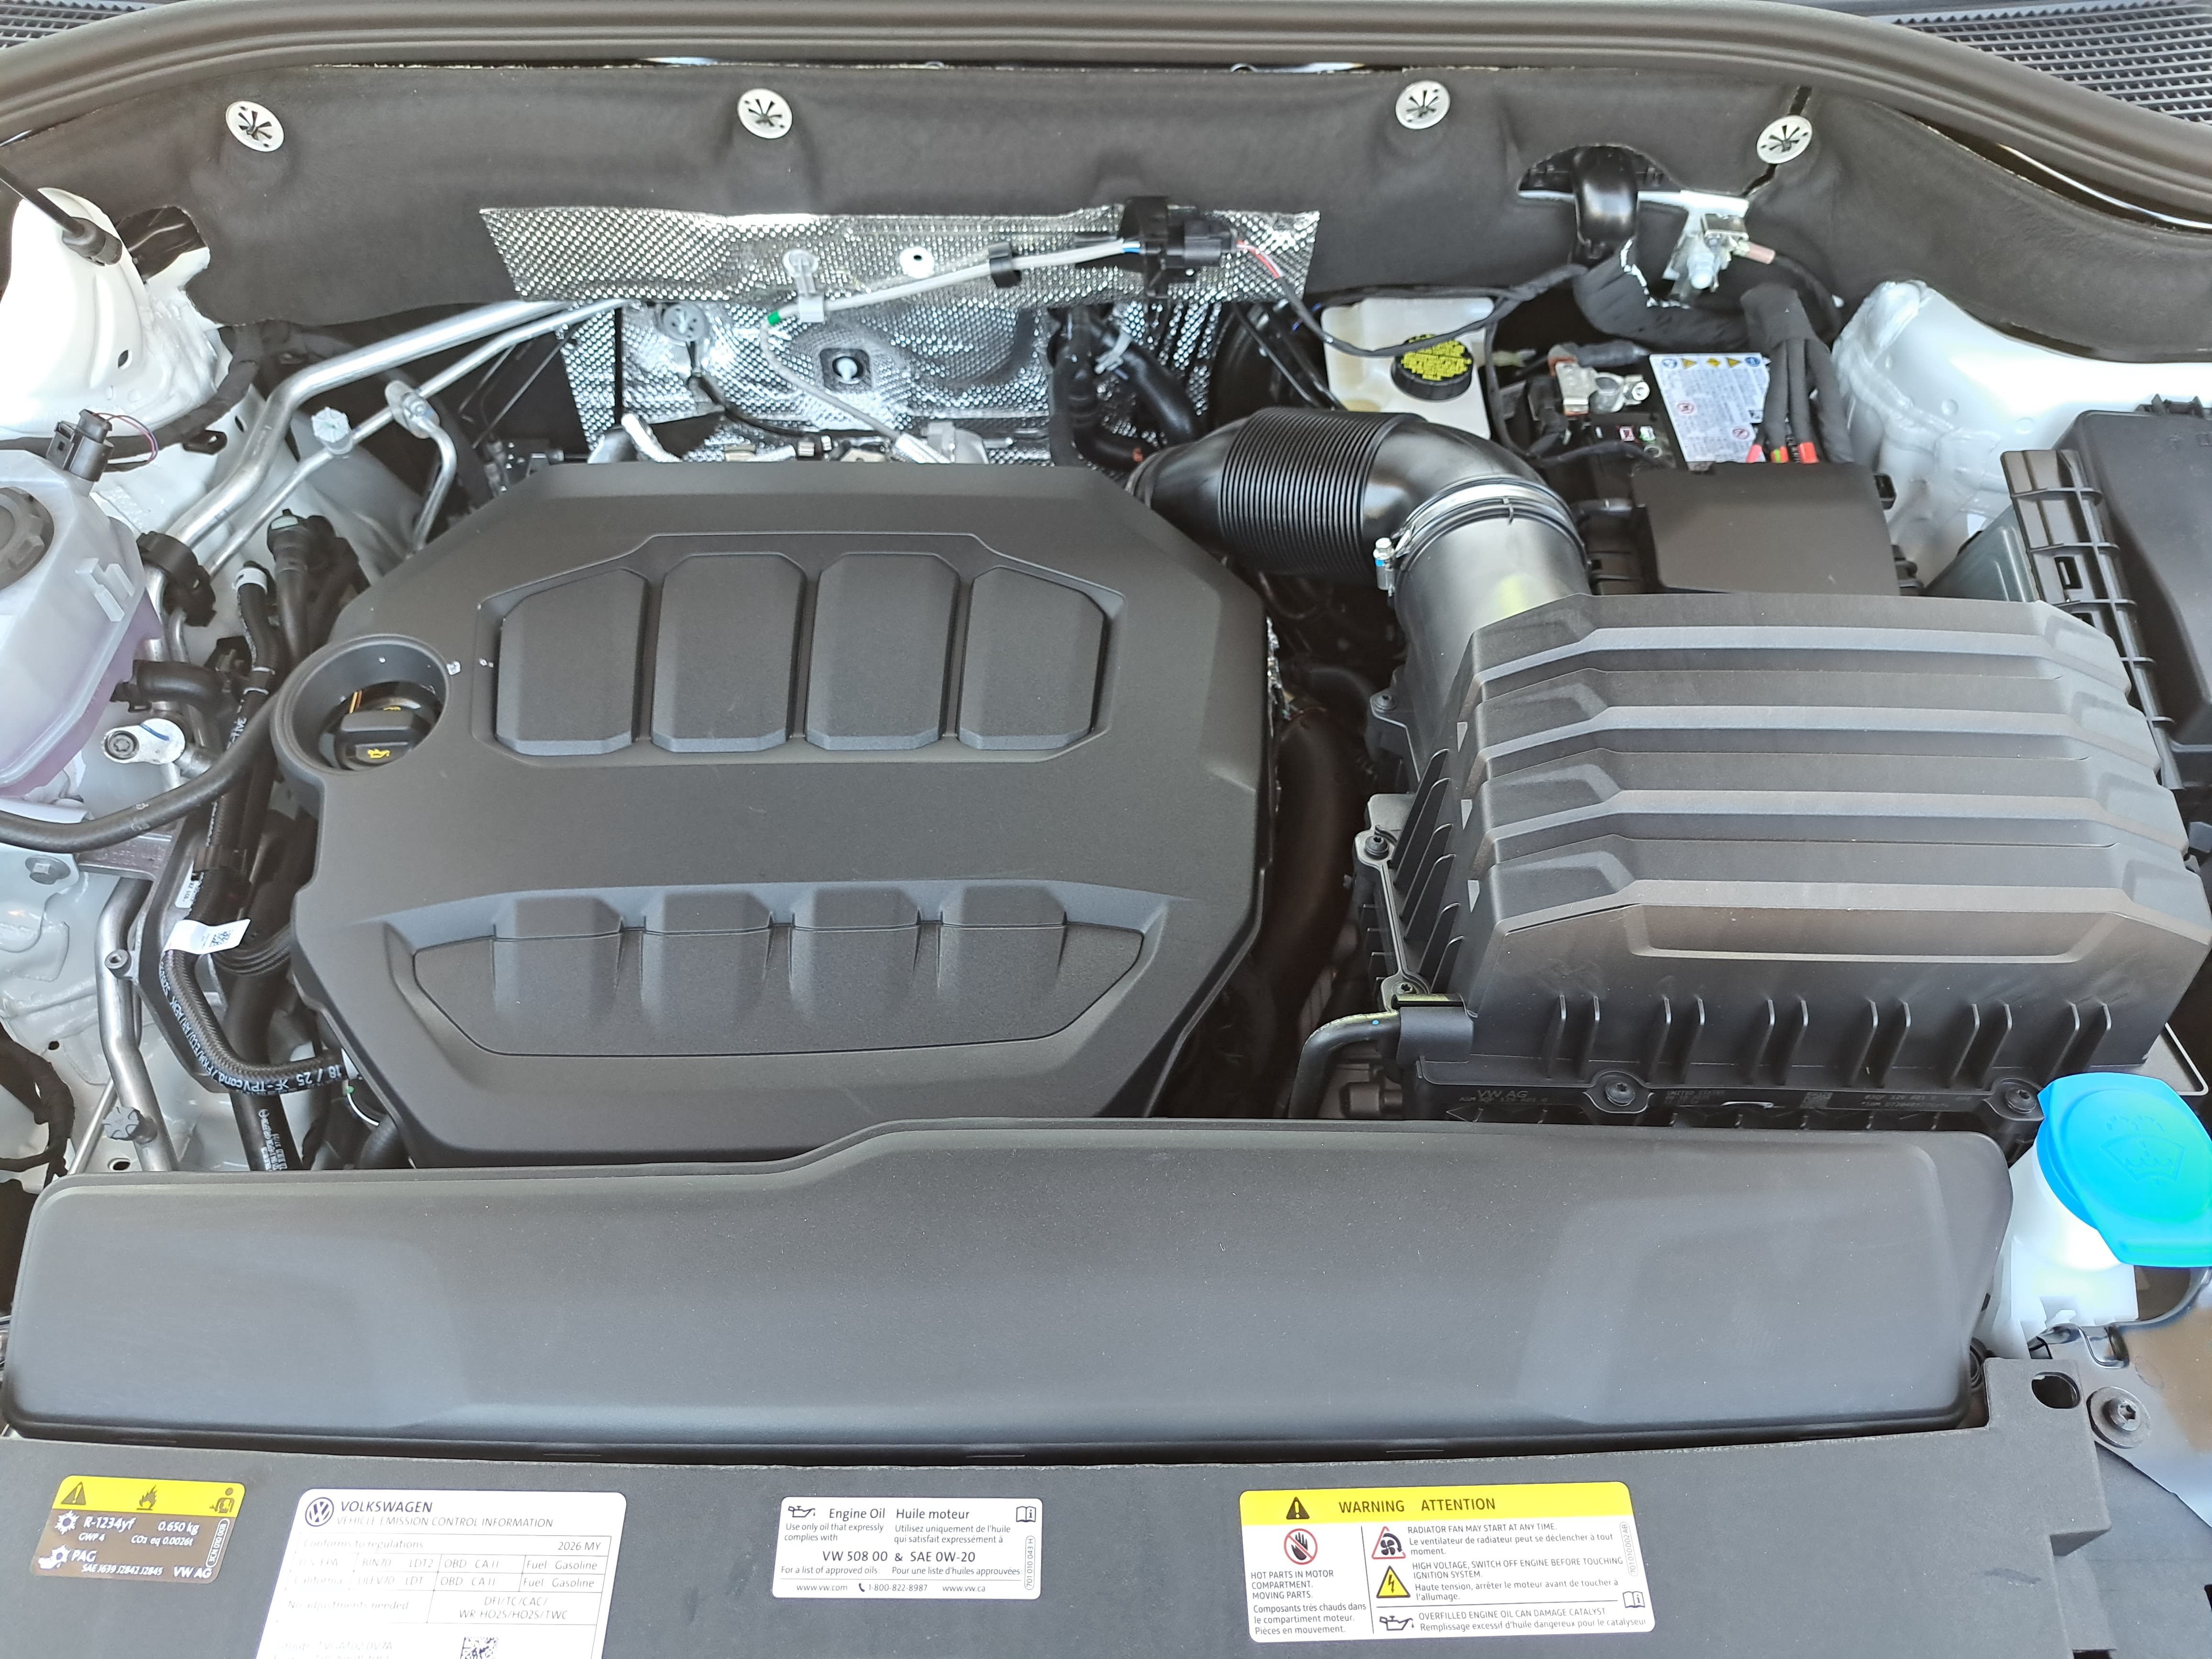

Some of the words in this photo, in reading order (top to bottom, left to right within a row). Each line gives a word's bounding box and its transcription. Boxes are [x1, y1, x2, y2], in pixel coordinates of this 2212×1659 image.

[342, 1501, 432, 1512] VOLKSWAGEN
[1339, 1500, 1405, 1513] WARNING
[1421, 1498, 1495, 1511] ATTENTION
[830, 1508, 866, 1522] Engine
[870, 1508, 885, 1518] Oil
[896, 1508, 925, 1518] Huile
[929, 1509, 969, 1519] moteur
[84, 1516, 136, 1532] R-1234yf
[158, 1521, 186, 1532] 0.650
[187, 1522, 199, 1535] kg
[380, 1517, 428, 1526] EMISSION
[432, 1517, 476, 1526] CONTROL
[482, 1518, 553, 1527] INFORMATION
[802, 1523, 818, 1533] only
[849, 1523, 884, 1533] expressly
[926, 1526, 973, 1534] uniquement
[78, 1532, 99, 1541] GWP
[150, 1538, 161, 1547] eq
[785, 1533, 818, 1542] complies
[942, 1536, 996, 1545] expressément
[1515, 1536, 1533, 1544] peut
[368, 1539, 423, 1550] regulations
[558, 1542, 581, 1550] 2026
[71, 1550, 97, 1562] PAG
[823, 1551, 843, 1561] VW
[847, 1551, 868, 1561] 508
[873, 1551, 887, 1561] 00
[895, 1553, 903, 1561] &
[911, 1551, 931, 1561] SAE
[936, 1552, 975, 1562] 0W-20
[409, 1559, 433, 1568] LDT2
[555, 1561, 597, 1570] Gasoline
[81, 1564, 98, 1572] SAE
[174, 1567, 194, 1578] VW
[194, 1565, 214, 1578] AG
[826, 1566, 862, 1576] approved
[553, 1578, 594, 1587] Gasoline
[1252, 1581, 1313, 1589] COMPARTMENT.
[1416, 1593, 1460, 1602] l'allumage.
[1254, 1605, 1301, 1614] Composants
[1319, 1603, 1346, 1611] chauds
[1264, 1615, 1321, 1625] compartiment
[1419, 1612, 1466, 1620] OVERFILLED
[1420, 1623, 1470, 1632] Remplissage
[1472, 1621, 1502, 1629] excessif
[1534, 1620, 1575, 1629] dangereux
